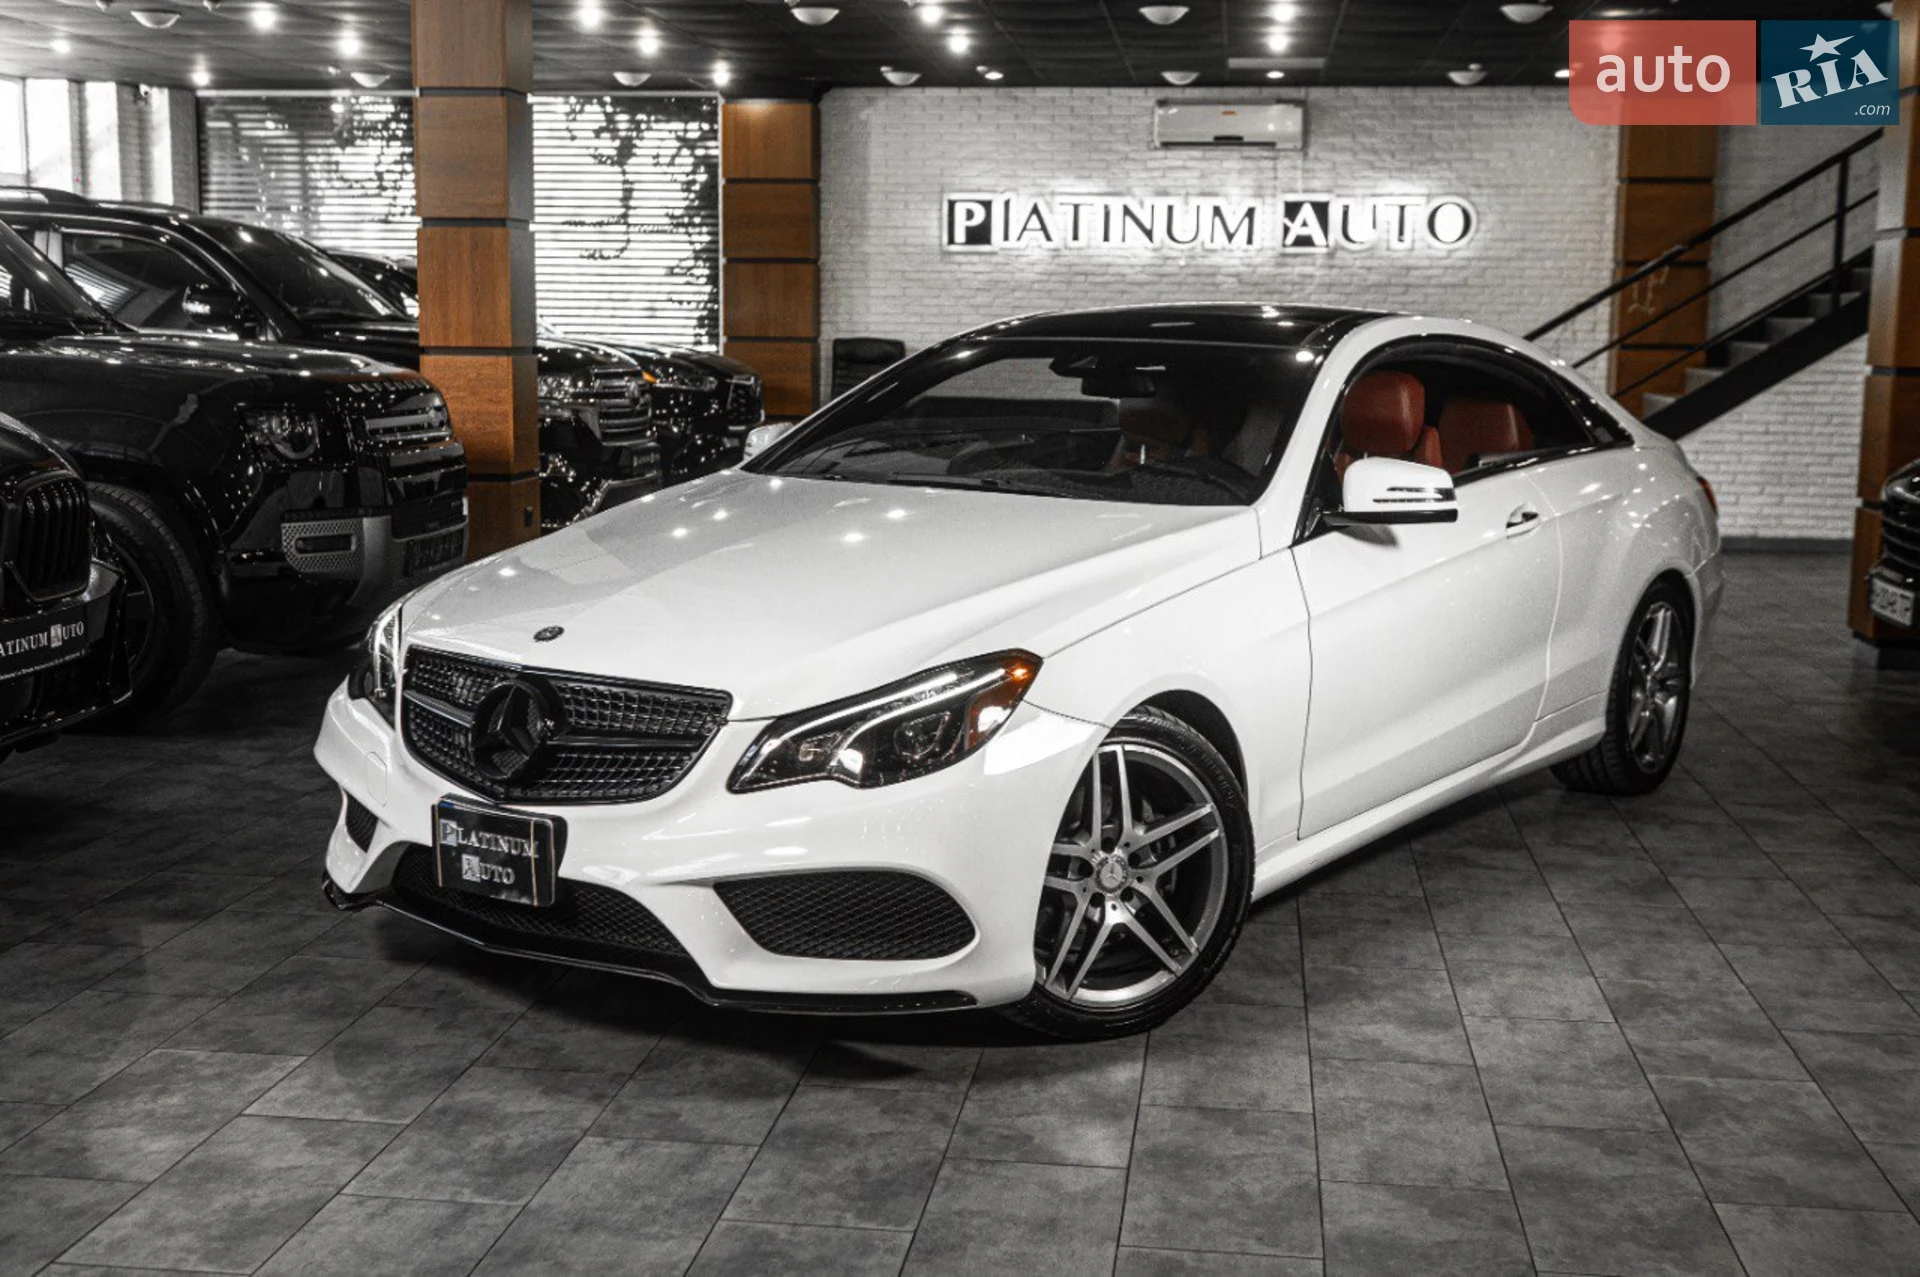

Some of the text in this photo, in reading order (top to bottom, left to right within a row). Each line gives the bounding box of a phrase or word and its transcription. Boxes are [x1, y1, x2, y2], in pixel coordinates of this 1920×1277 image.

[1283, 199, 1473, 247] AUTO
[440, 818, 539, 858] PLATINUM
[461, 853, 515, 885] AUTO
